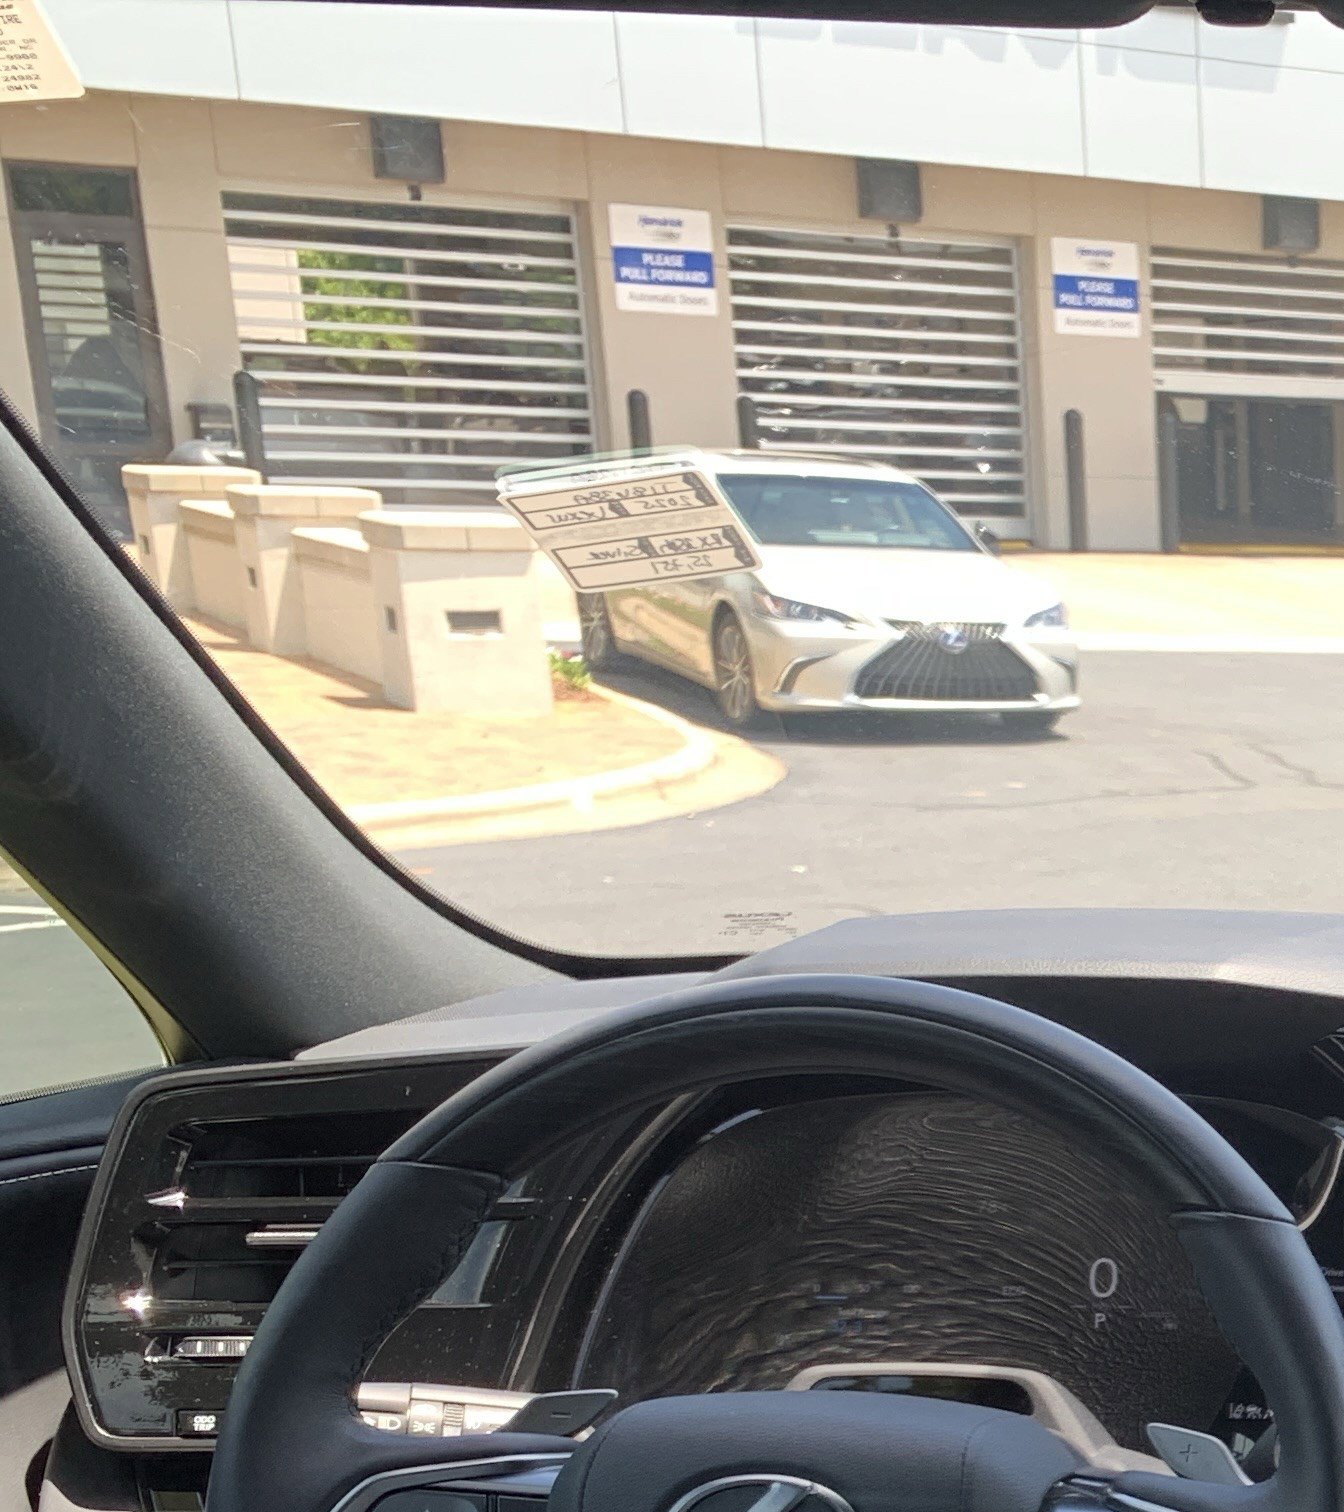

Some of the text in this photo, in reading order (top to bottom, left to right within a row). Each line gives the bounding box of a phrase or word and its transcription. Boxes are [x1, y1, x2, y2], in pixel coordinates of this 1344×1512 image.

[642, 252, 684, 268] PLEASE
[620, 265, 709, 284] PULL FORWARD
[1078, 281, 1115, 294] PLEASE
[1059, 292, 1135, 309] PULL FORWARD
[1089, 1257, 1118, 1298] 0
[1094, 1312, 1107, 1329] P
